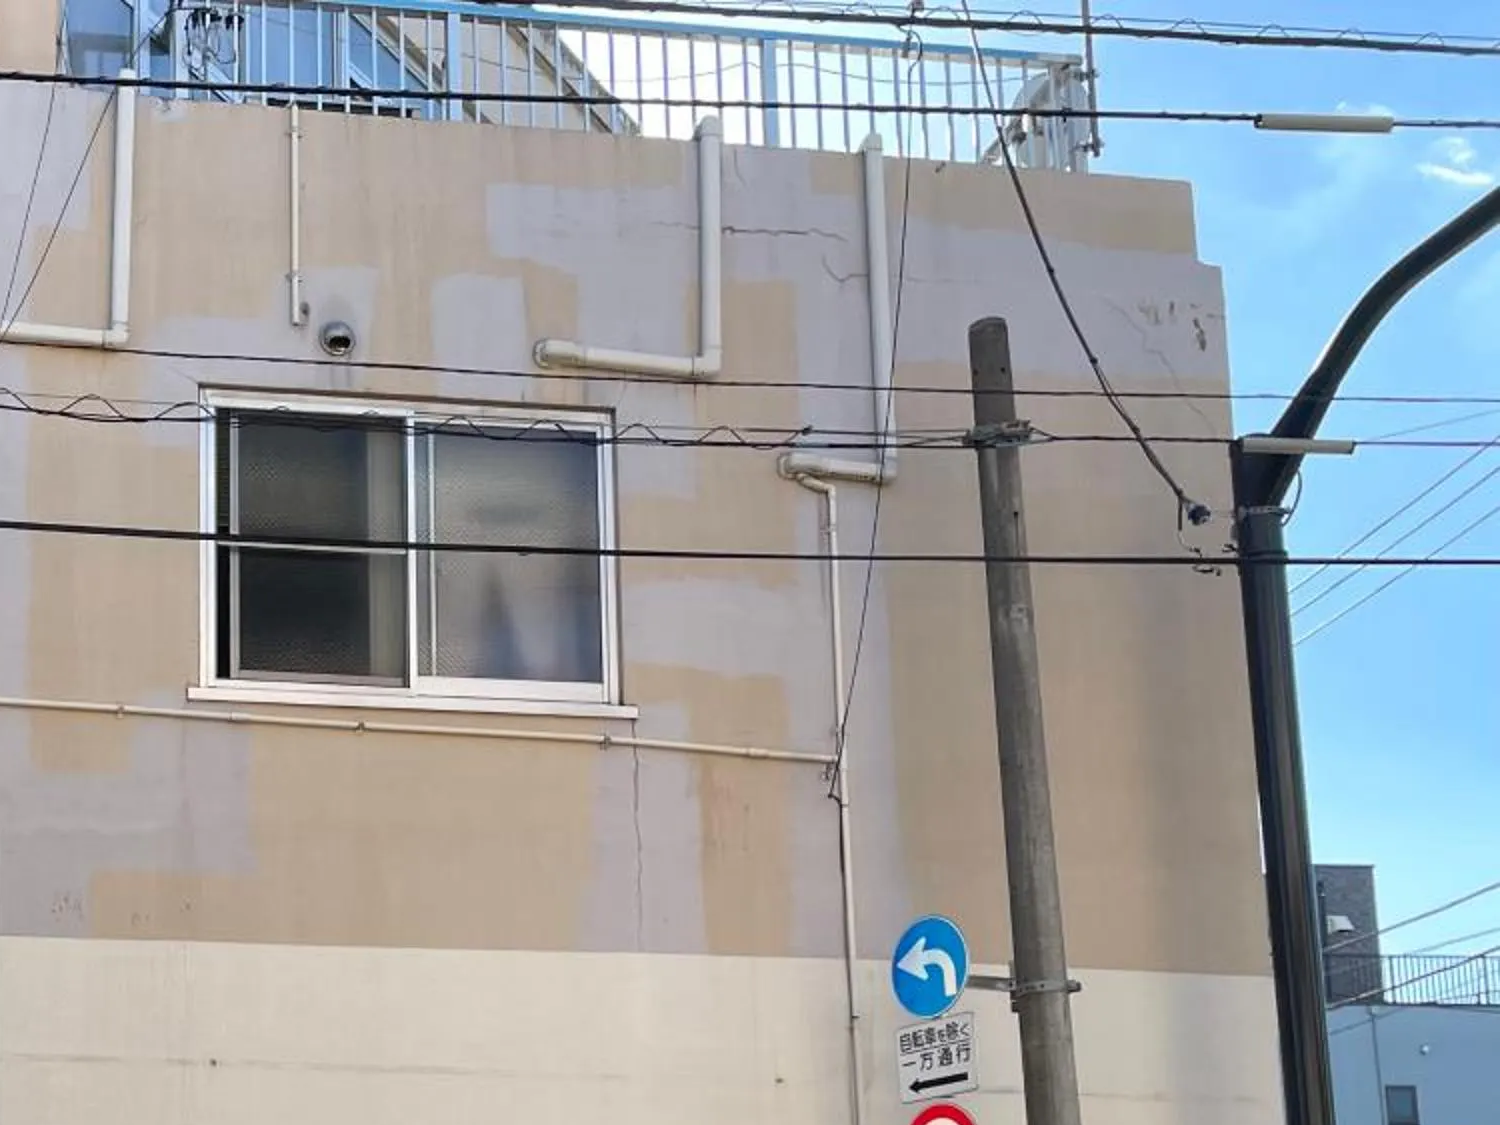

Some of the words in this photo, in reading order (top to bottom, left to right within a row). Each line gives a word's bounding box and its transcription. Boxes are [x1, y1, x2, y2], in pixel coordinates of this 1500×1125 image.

[900, 1022, 972, 1053] 自転車を除く
[902, 1044, 970, 1071] 一方通行
